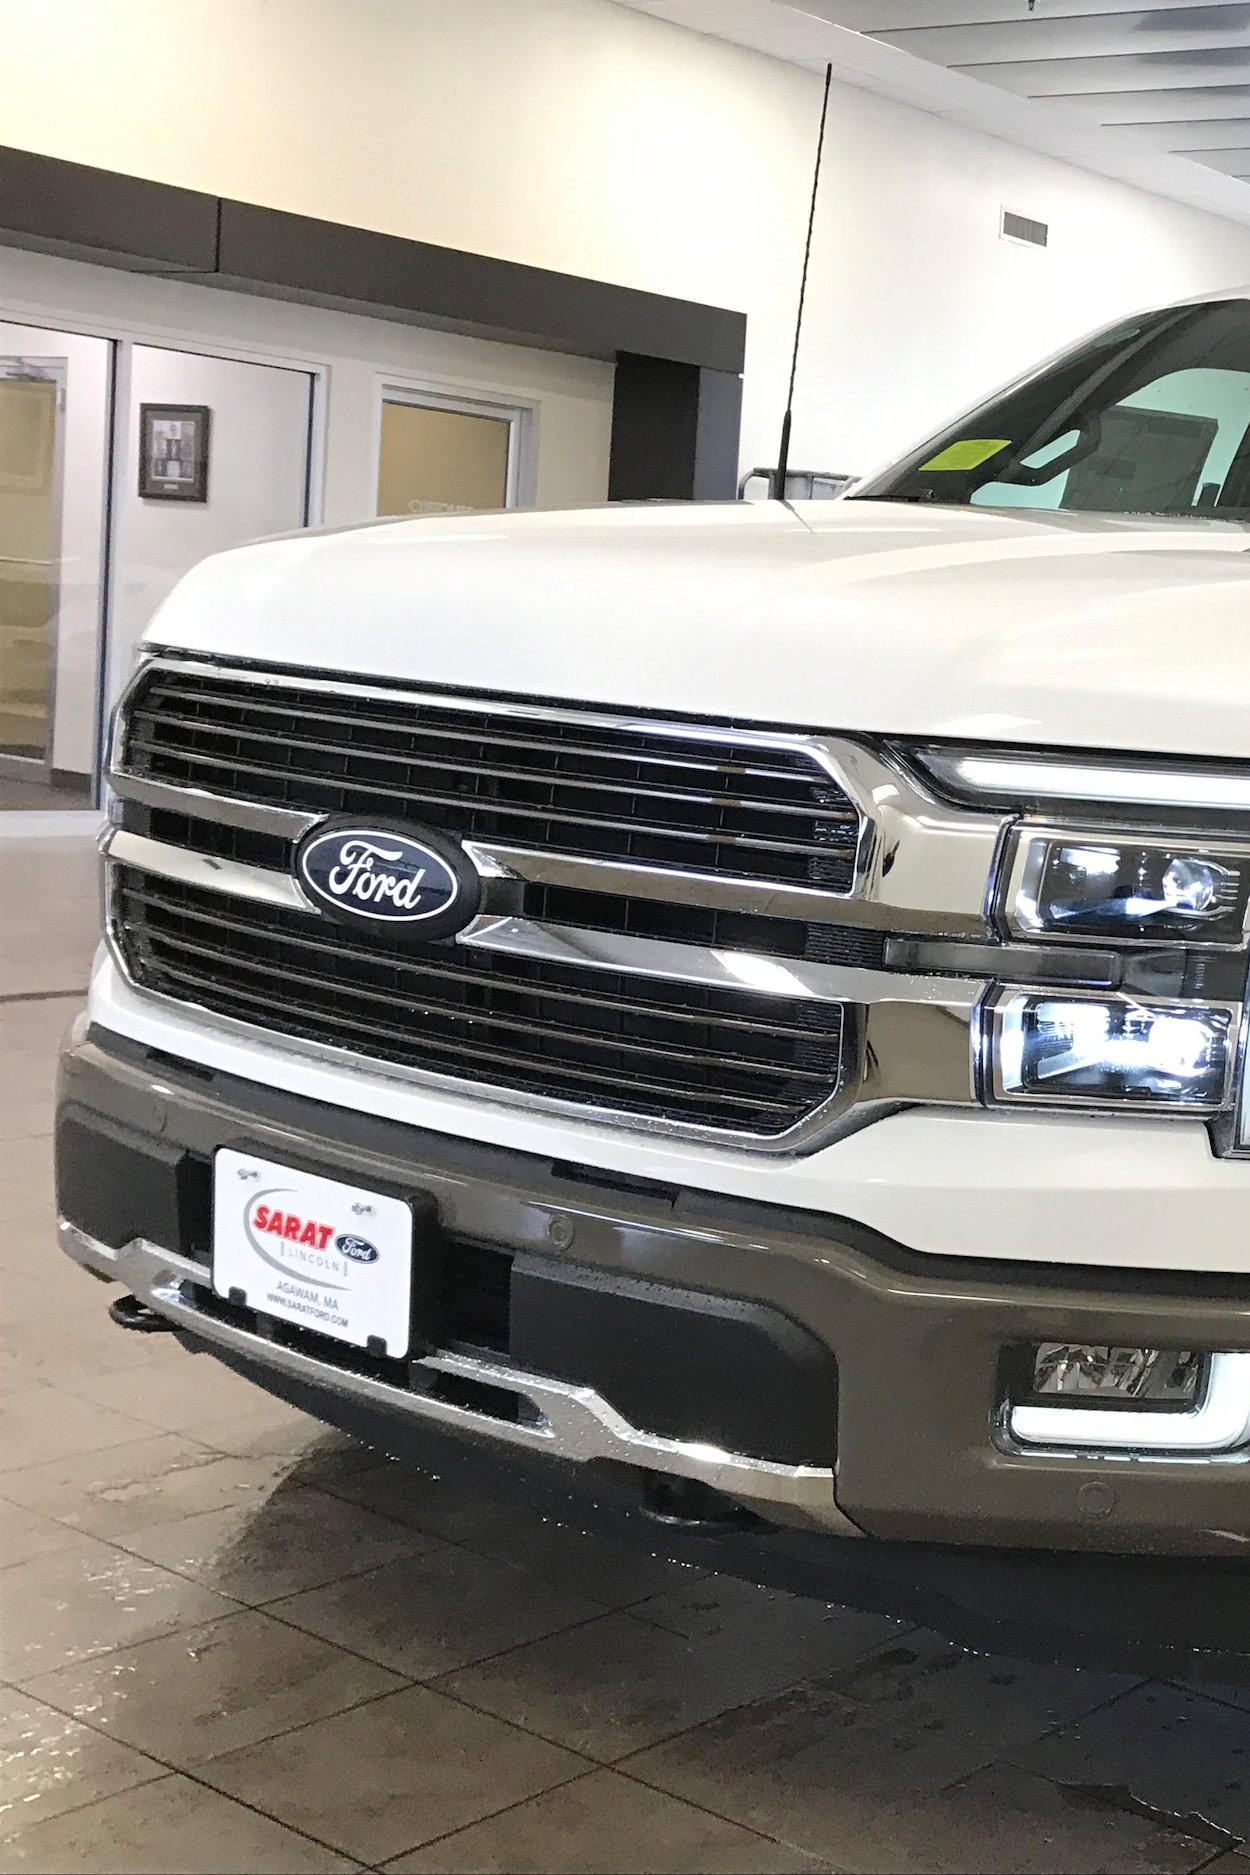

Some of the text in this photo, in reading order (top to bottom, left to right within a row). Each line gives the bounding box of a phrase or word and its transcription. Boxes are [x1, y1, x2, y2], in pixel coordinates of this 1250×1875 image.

[328, 840, 426, 910] Ford
[253, 1205, 334, 1250] SARAT
[287, 1248, 340, 1272] LINCOLN
[266, 1292, 349, 1328] WWW.SARATFORD.COM
[276, 1280, 340, 1311] AGAWAM, MA
